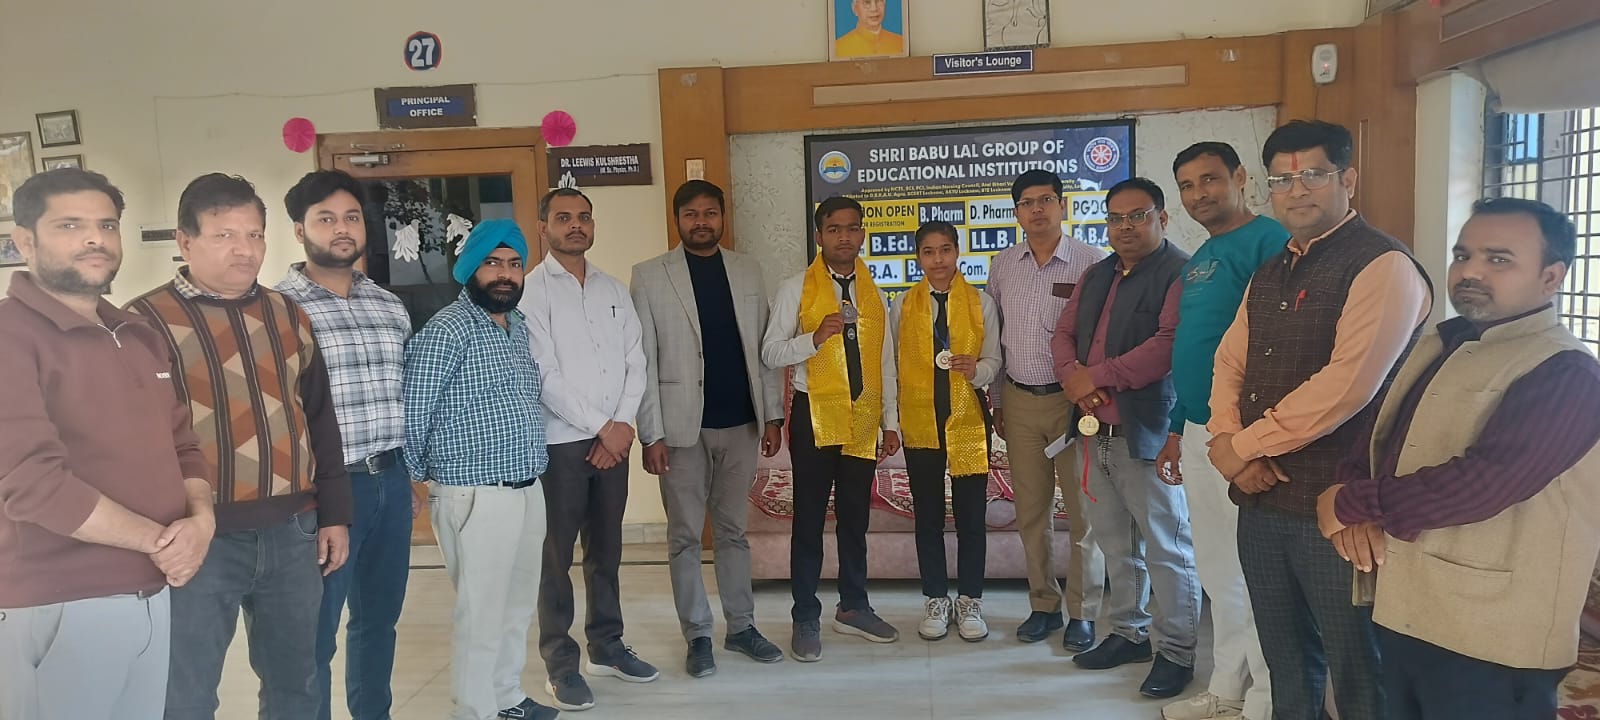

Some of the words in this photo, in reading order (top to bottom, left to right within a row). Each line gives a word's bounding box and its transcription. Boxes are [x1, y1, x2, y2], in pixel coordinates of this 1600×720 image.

[408, 37, 435, 67] 27
[945, 57, 983, 68] Visitor's
[986, 56, 1022, 66] Lounge
[401, 96, 450, 106] PRINCIPAL
[410, 108, 444, 117] OFFICE
[870, 148, 904, 163] SHRI
[909, 145, 949, 161] BABU
[954, 144, 978, 159] LAL
[982, 141, 1040, 158] GROUP
[1042, 140, 1064, 154] OF
[596, 156, 639, 166] KULSHRESTHA
[858, 163, 966, 182] EDUCATIONAL
[969, 158, 1078, 178] INSTITUTIONS
[886, 205, 914, 217] OPEN
[920, 206, 930, 222] B.
[932, 206, 964, 222] Pharm
[971, 205, 980, 220] D.
[872, 234, 913, 252] B.Ed.
[972, 230, 1014, 250] LL.B.
